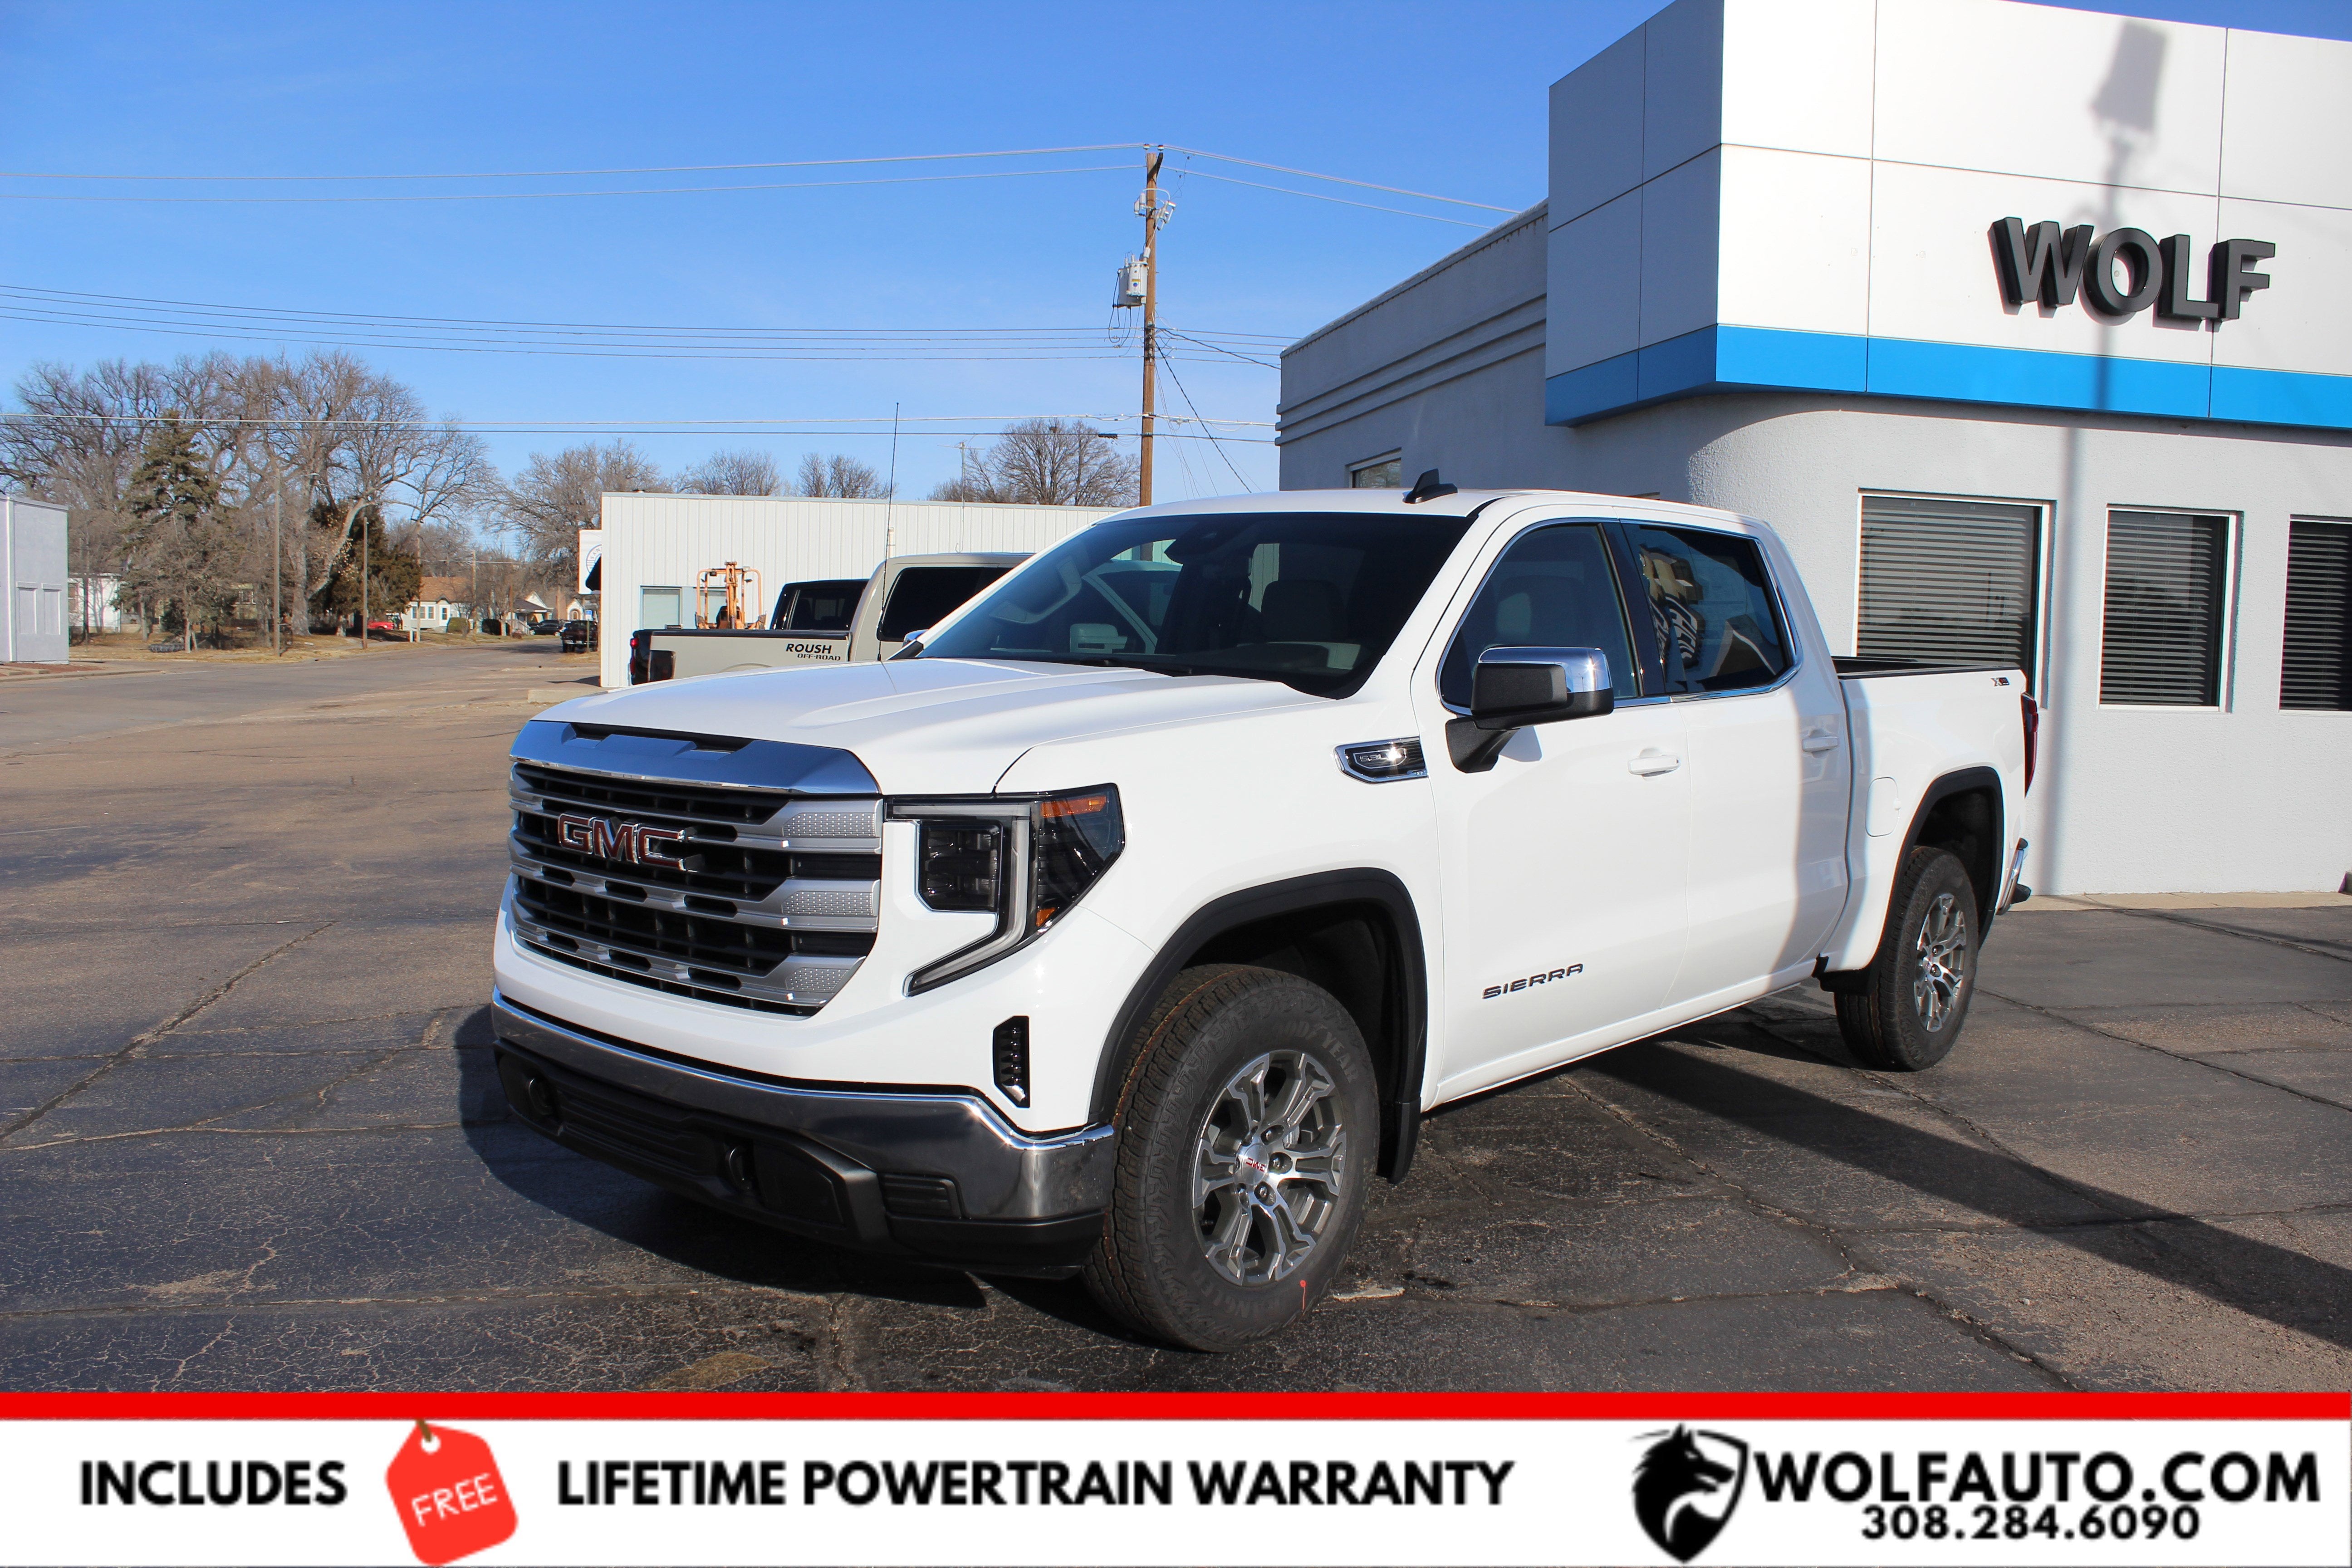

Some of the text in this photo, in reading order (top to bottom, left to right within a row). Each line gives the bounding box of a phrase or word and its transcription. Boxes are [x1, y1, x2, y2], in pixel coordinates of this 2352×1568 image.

[1987, 216, 2276, 320] WOLF
[786, 643, 833, 654] ROUSH
[558, 813, 686, 871] GMC
[1482, 963, 1583, 999] SIERRA
[1245, 1157, 1267, 1172] GMC
